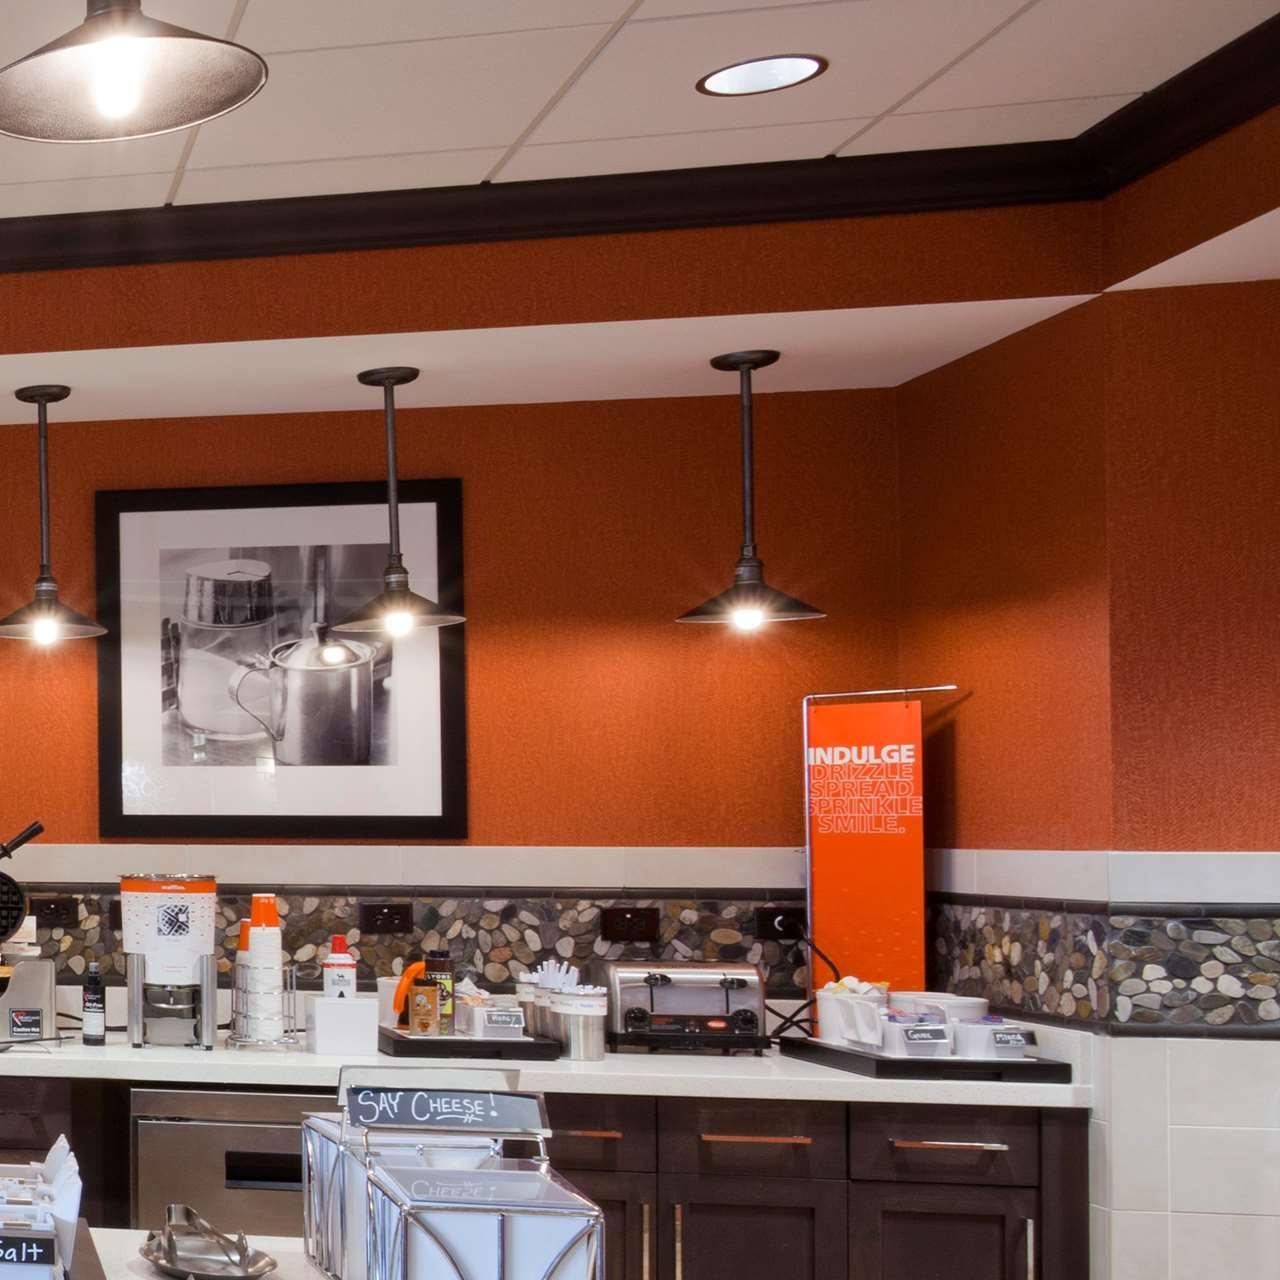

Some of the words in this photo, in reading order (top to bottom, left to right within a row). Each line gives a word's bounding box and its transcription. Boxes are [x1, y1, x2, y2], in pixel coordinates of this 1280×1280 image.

[808, 744, 915, 766] INDULGE
[810, 763, 914, 781] DRIZZLE
[810, 780, 914, 798] SPREAD
[818, 814, 906, 834] SMILE.
[358, 1090, 404, 1123] SAY
[411, 1091, 498, 1122] CHEESE!
